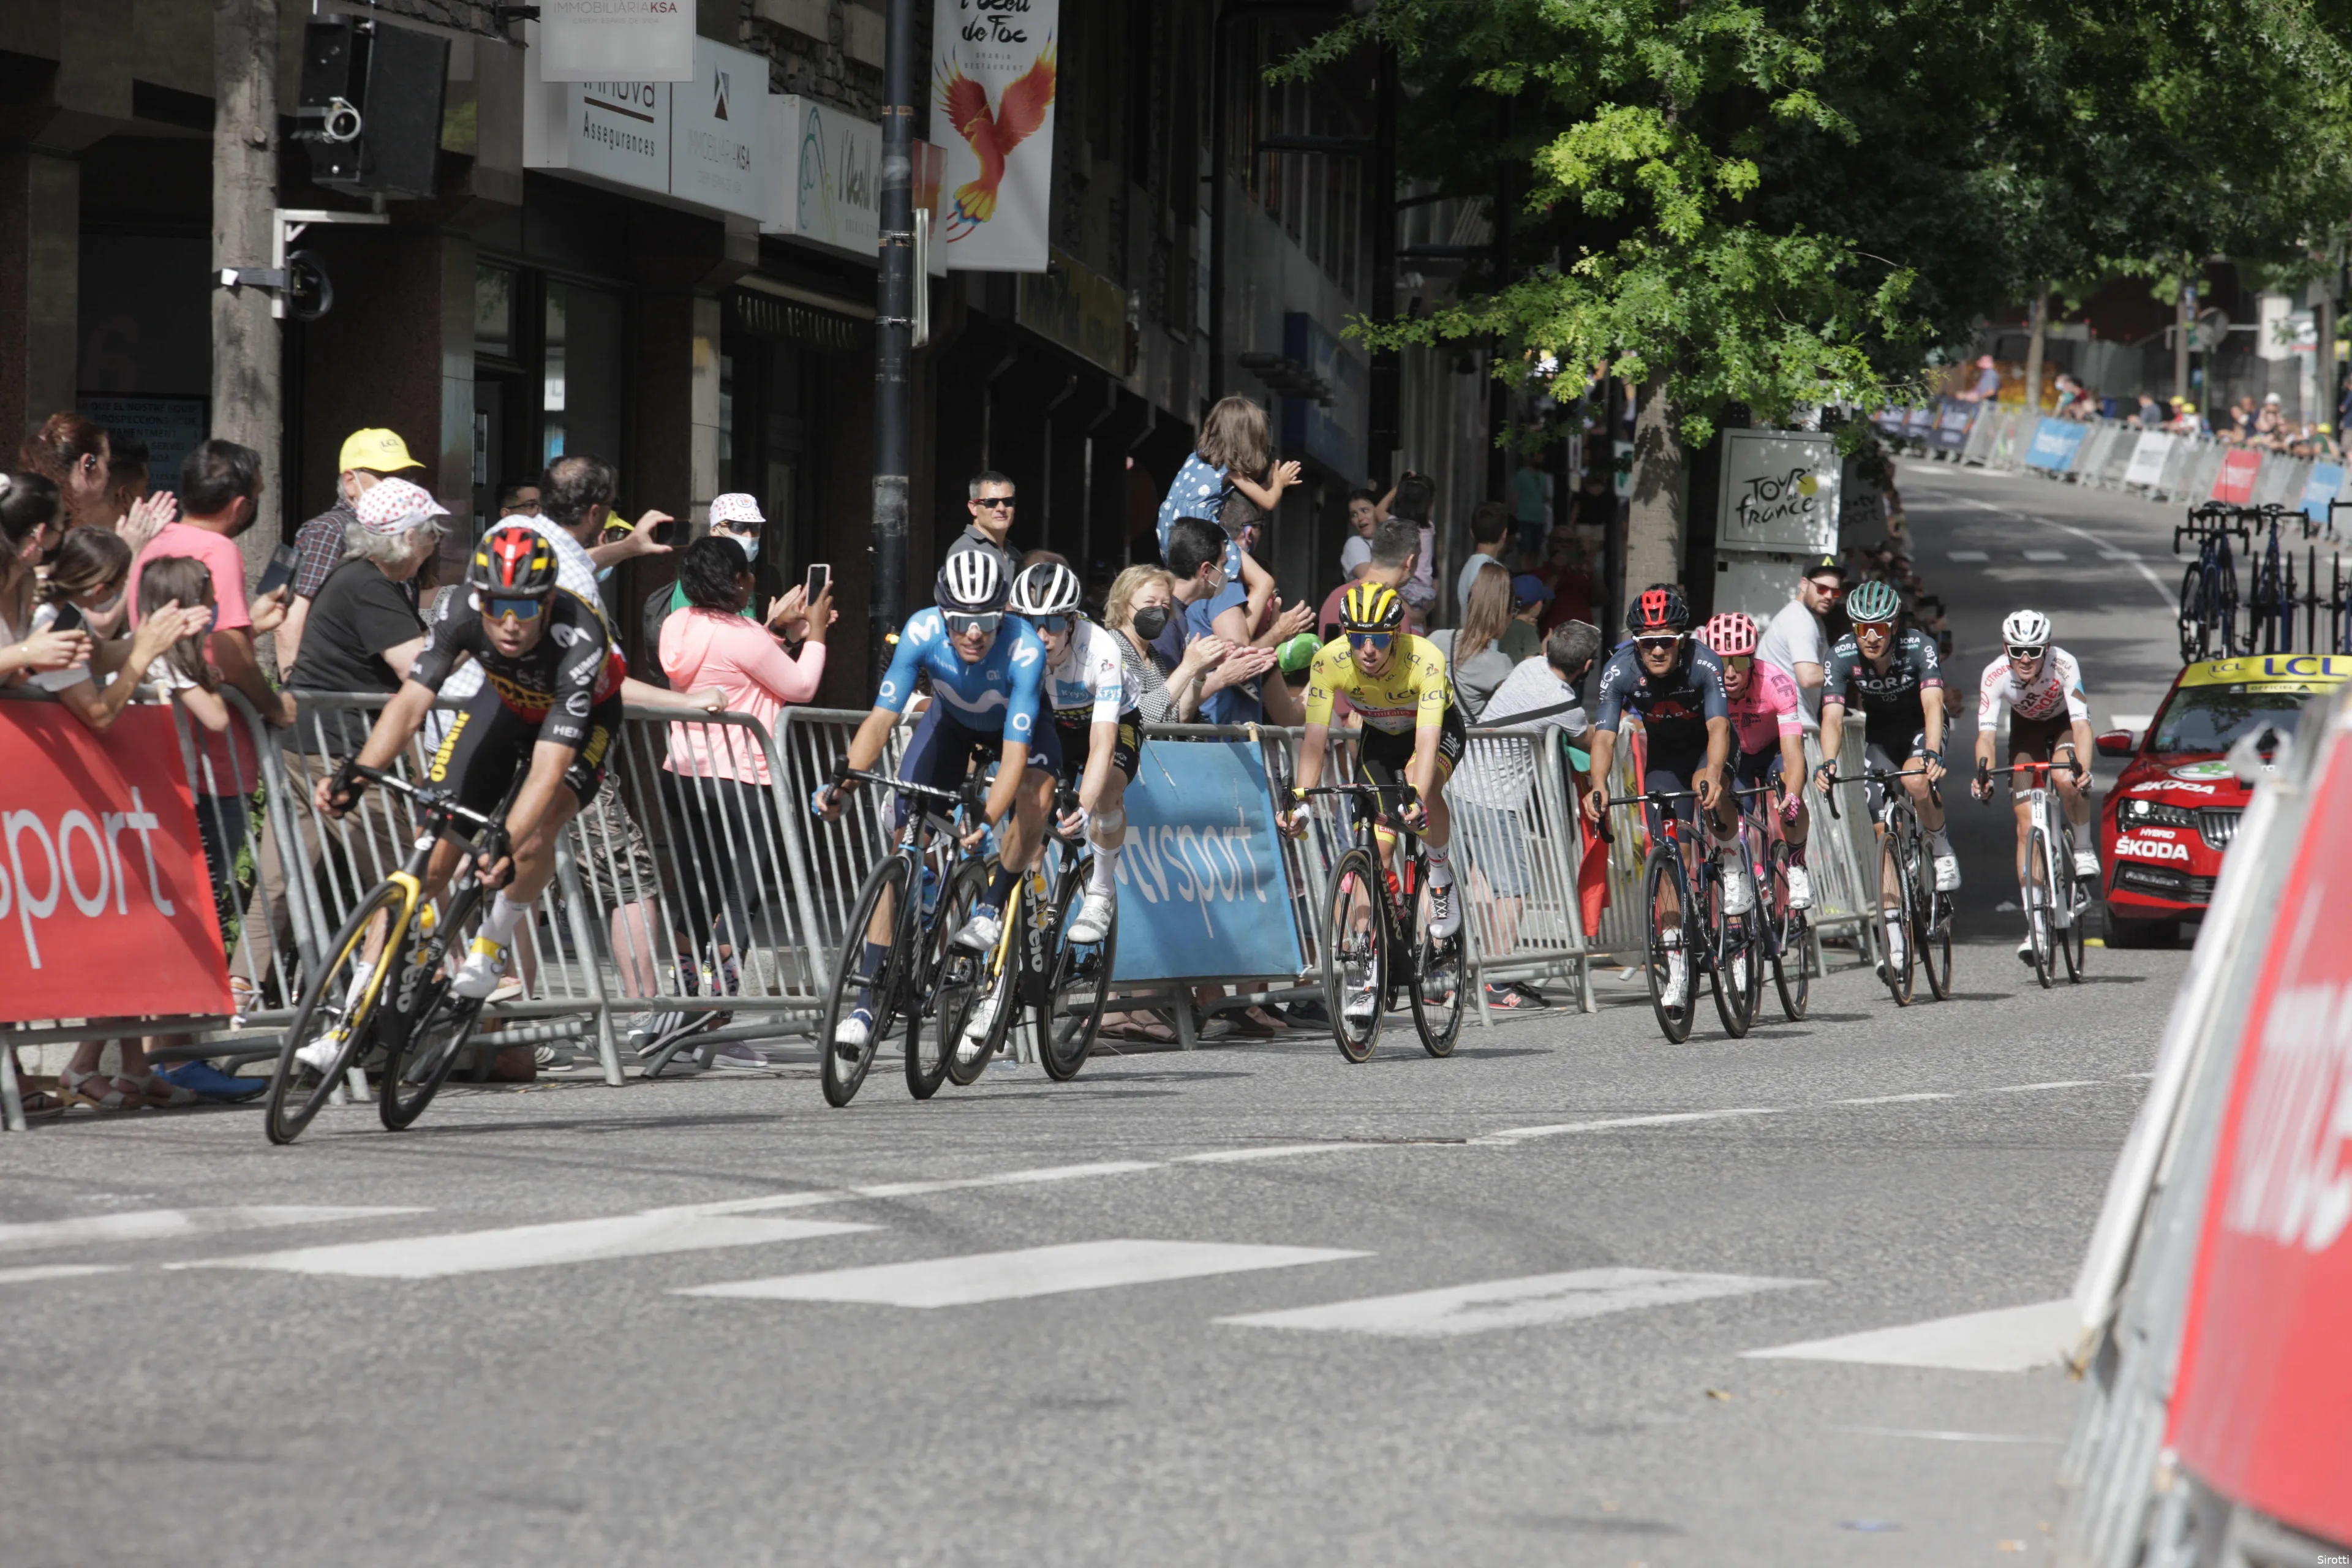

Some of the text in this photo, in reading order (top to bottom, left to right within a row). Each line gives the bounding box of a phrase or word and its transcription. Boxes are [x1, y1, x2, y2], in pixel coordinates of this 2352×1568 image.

[583, 110, 655, 157] Assegurances
[1834, 643, 1858, 654] BORA
[2212, 657, 2348, 676] LCL LCL
[1388, 689, 1420, 700] LCL
[2139, 828, 2176, 839] HYBRID
[2114, 835, 2190, 861] ŠKODA
